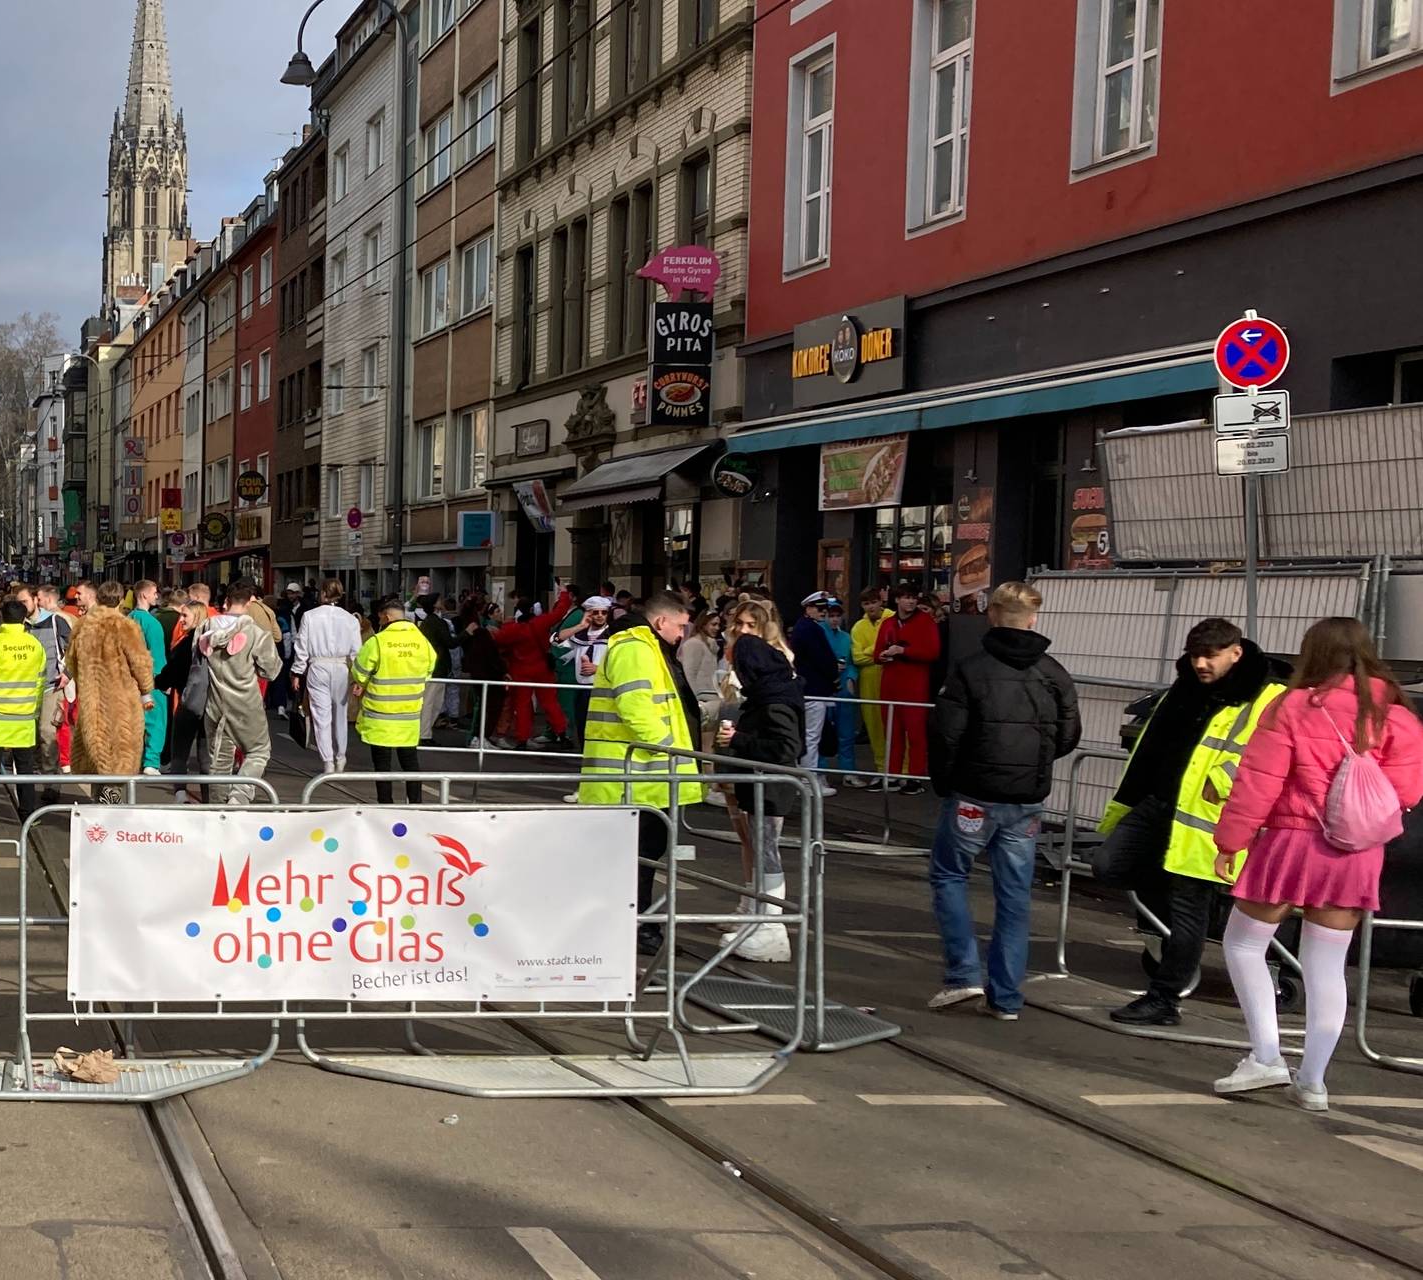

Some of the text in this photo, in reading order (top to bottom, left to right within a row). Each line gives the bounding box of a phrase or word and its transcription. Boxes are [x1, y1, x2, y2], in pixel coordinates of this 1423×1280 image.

[663, 256, 712, 265] FERKULUM
[663, 266, 711, 276] Beste Gyros
[682, 275, 701, 284] Köln
[656, 311, 713, 337] GYROS
[666, 337, 702, 352] PITA
[834, 346, 855, 363] KOKO
[653, 371, 710, 391] CURRYWURST
[657, 402, 704, 418] POMMES
[239, 476, 264, 486] SOUL
[241, 486, 262, 495] BAR
[2, 644, 36, 652] Security
[387, 641, 421, 649] Security
[116, 830, 184, 844] Stadt Köln
[212, 852, 466, 918] Mehr Spaß
[213, 917, 445, 964] ohne Glas
[516, 955, 603, 967] www.stadt.koeln
[352, 966, 469, 990] Becher ist das!
